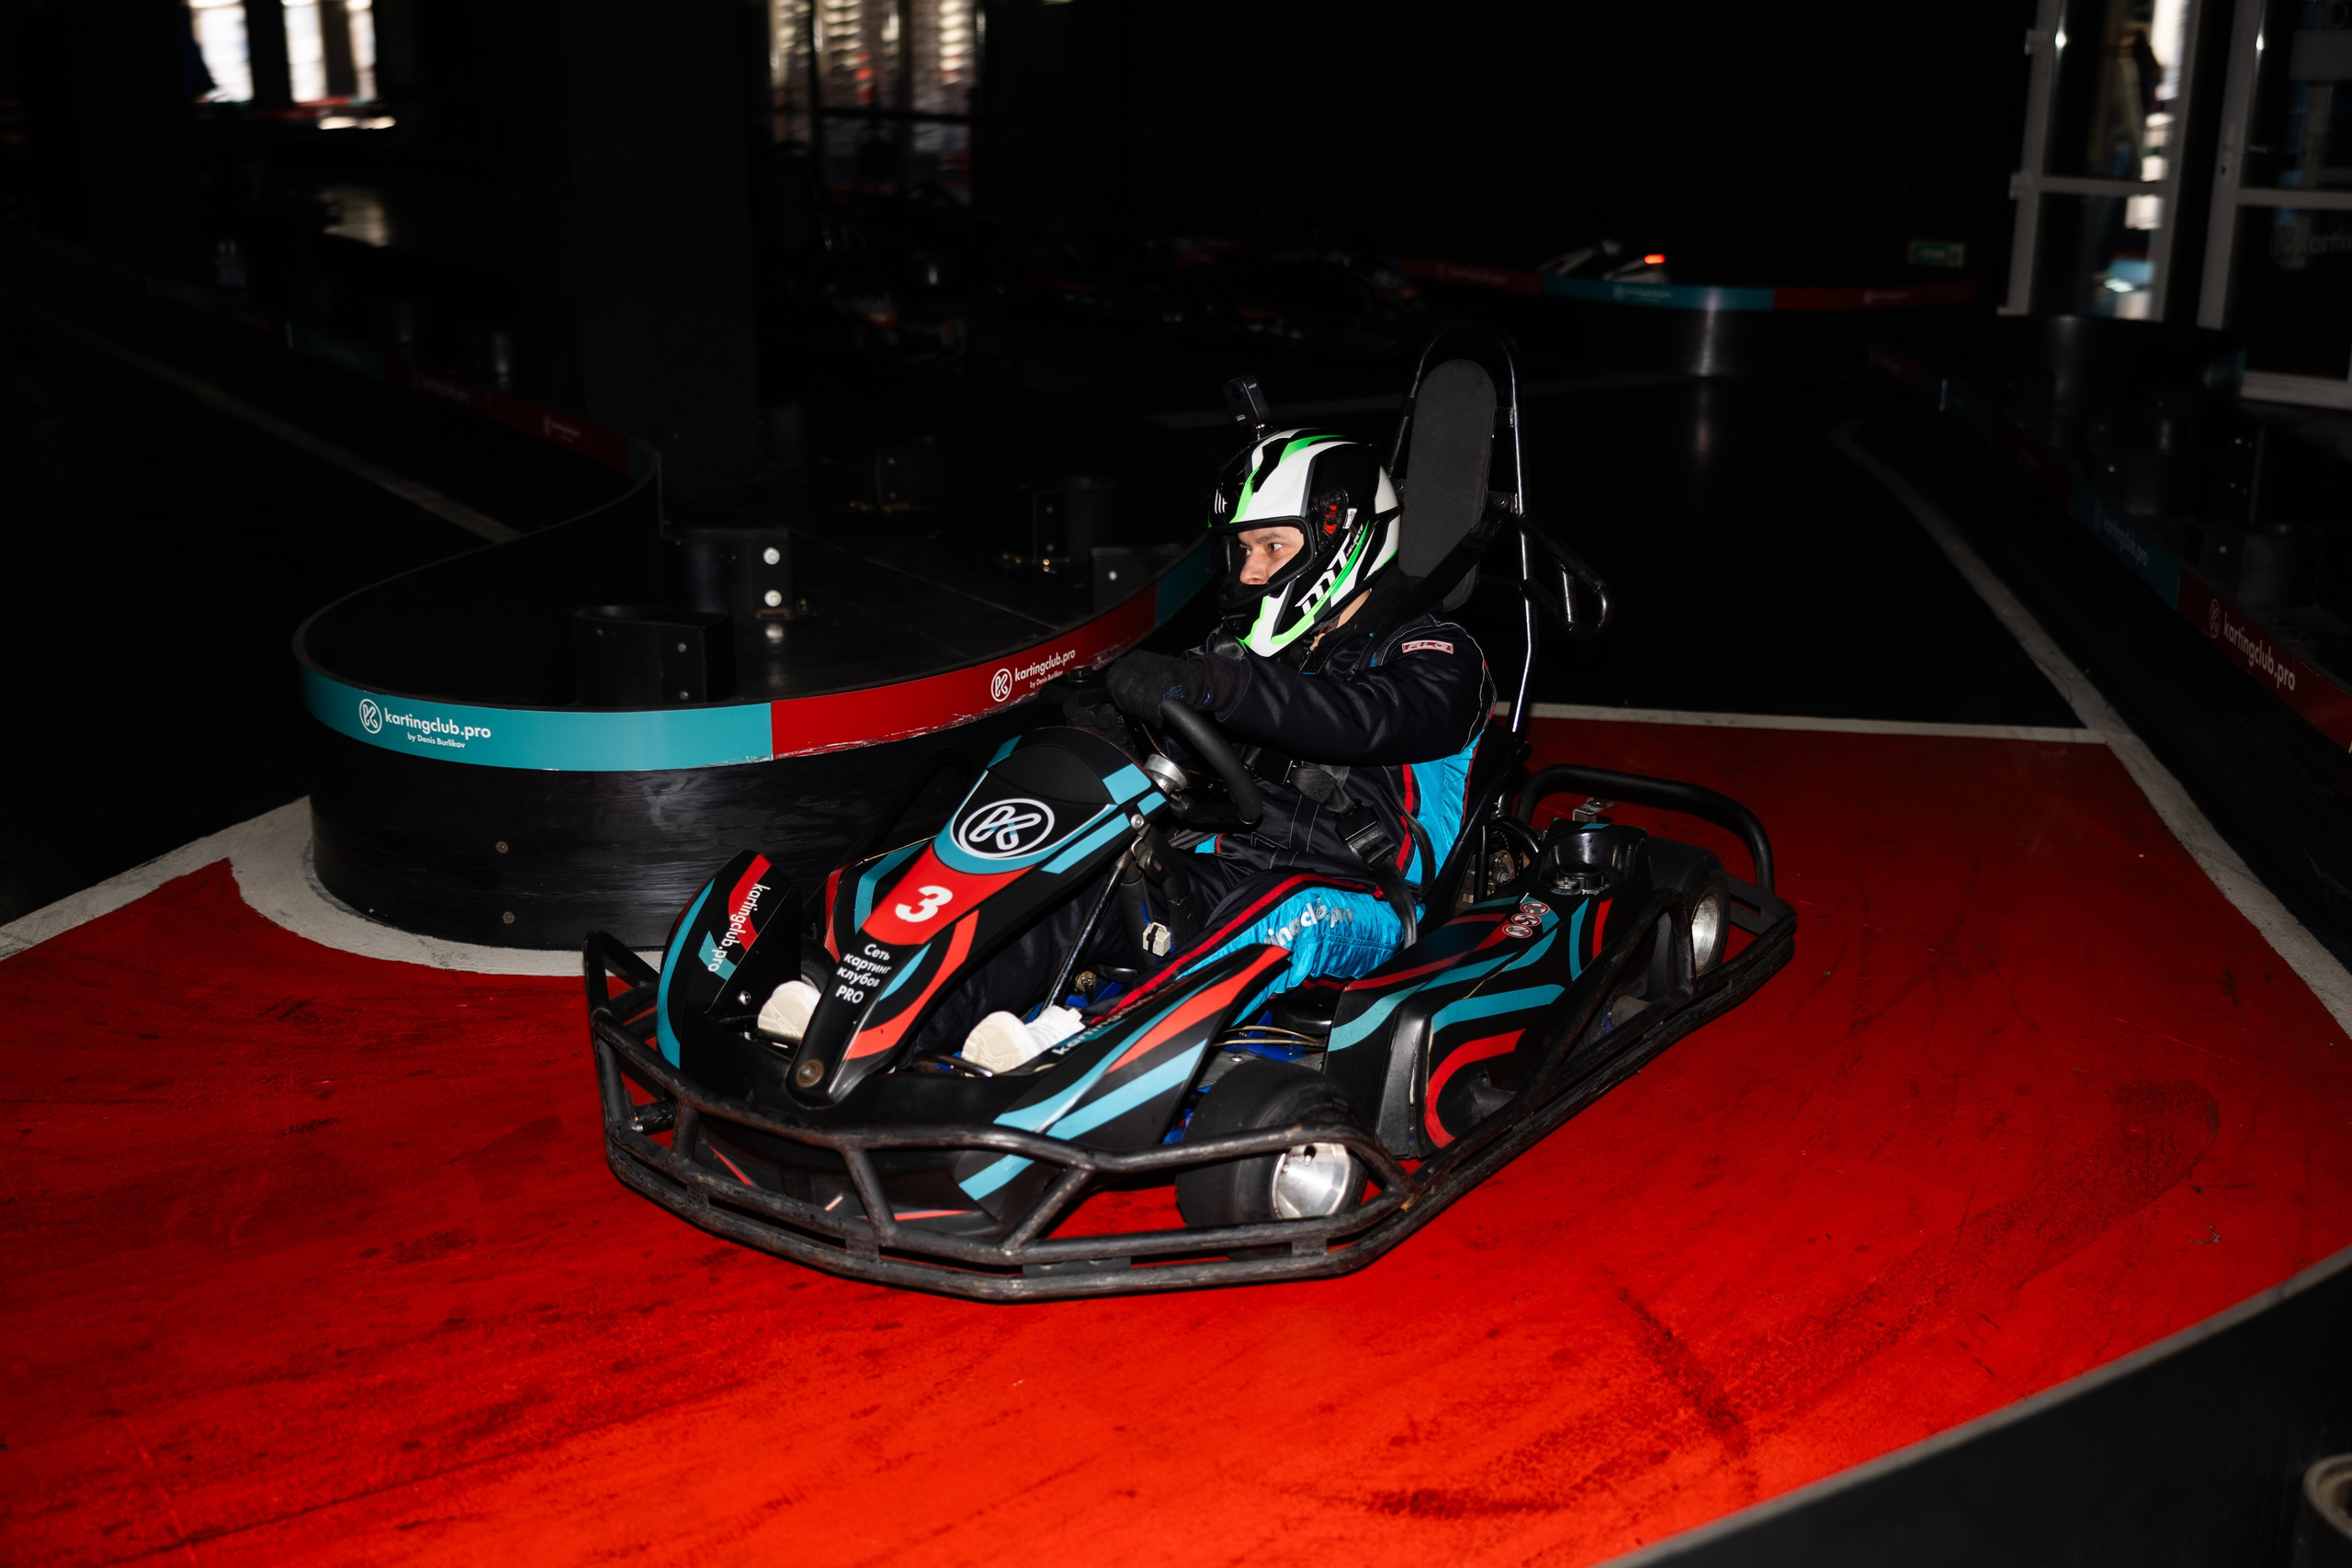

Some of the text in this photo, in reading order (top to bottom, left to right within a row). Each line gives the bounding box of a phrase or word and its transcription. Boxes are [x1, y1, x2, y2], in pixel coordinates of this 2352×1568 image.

[2222, 611, 2297, 691] kartingclub.pro
[1014, 649, 1076, 682] kartingclub.pro
[384, 706, 492, 740] kartingclub.pro
[407, 732, 416, 743] by
[417, 735, 436, 746] Denis
[895, 885, 953, 923] 3
[707, 883, 771, 973] kartingclub.pro
[843, 953, 891, 975] картинг
[864, 943, 890, 961] Сеть
[836, 966, 880, 987] клубов
[835, 985, 865, 1004] PRO
